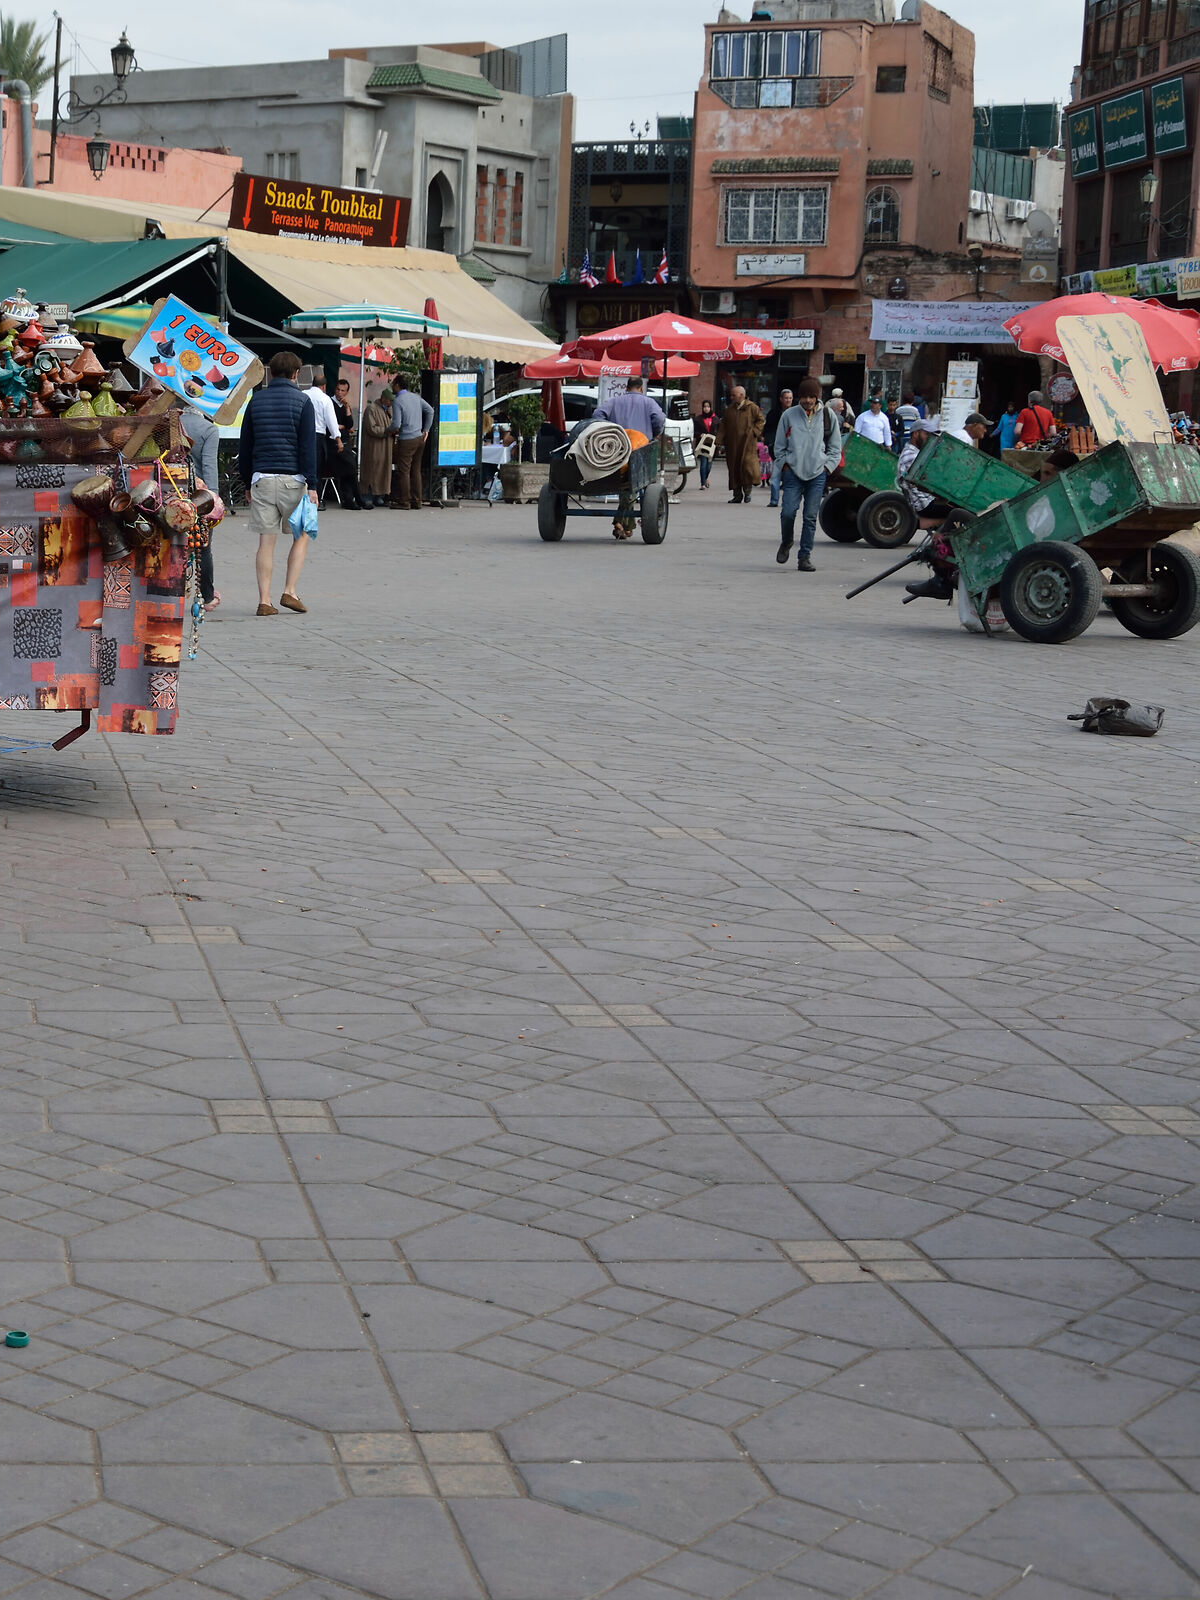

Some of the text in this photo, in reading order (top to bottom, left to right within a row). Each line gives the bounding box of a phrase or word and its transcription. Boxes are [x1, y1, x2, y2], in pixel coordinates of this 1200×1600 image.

[264, 181, 384, 221] Snack Toubkal
[271, 210, 374, 238] Terrasse Vue Panoramique
[169, 314, 240, 367] 1 EURO
